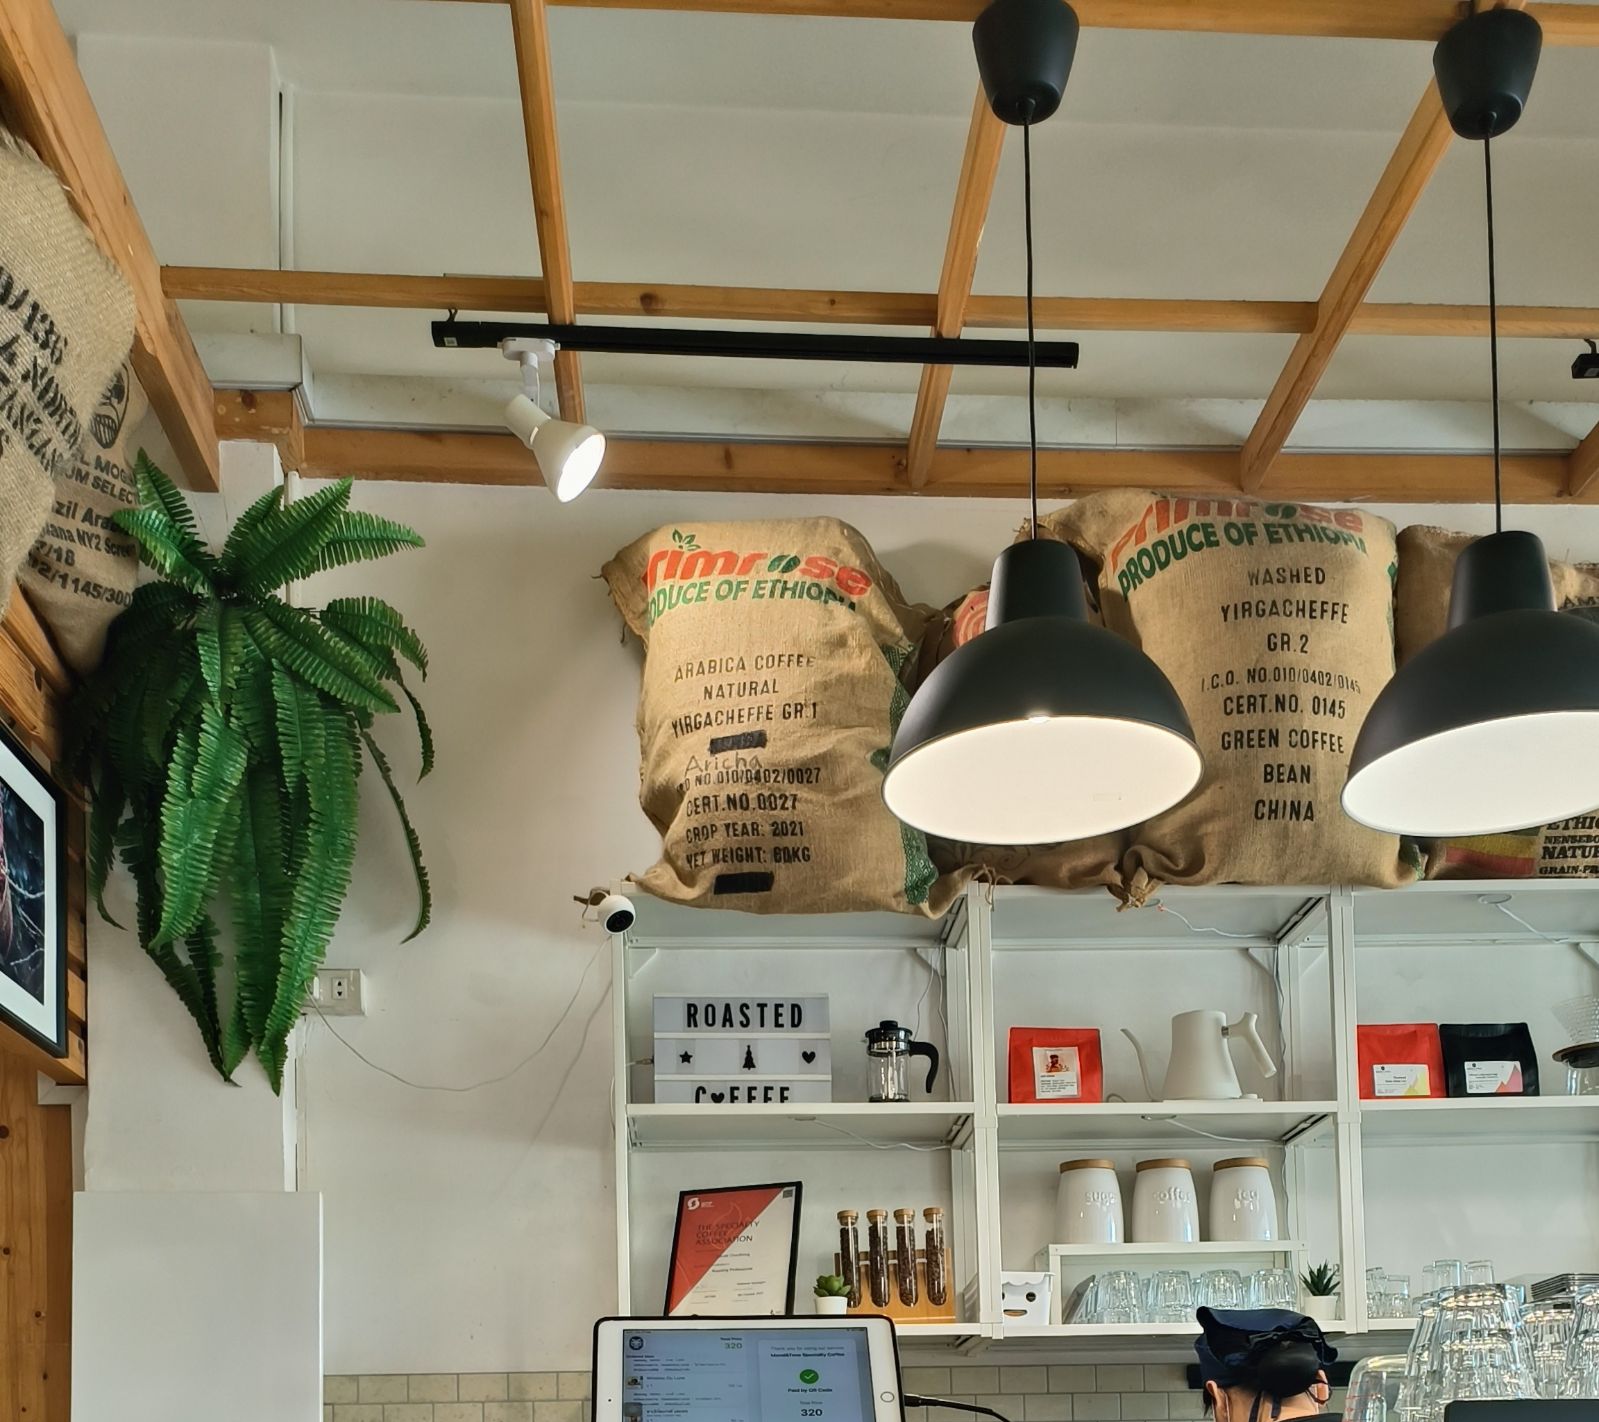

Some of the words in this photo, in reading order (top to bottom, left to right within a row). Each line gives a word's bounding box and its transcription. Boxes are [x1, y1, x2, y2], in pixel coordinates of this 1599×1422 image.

[76, 528, 102, 552] NY2
[1118, 522, 1220, 600] PRODUCE
[1223, 522, 1258, 546] OF
[1248, 567, 1326, 586] WASHED
[715, 580, 749, 602] OF
[1221, 599, 1349, 624] YIRGACHEFFE
[1267, 633, 1309, 654] GR.2
[674, 656, 746, 683] ARABICA
[754, 654, 816, 670] COFFEE
[704, 678, 779, 700] NATURAL
[1312, 696, 1345, 719] 0145
[672, 704, 773, 738] YIRGACHEFFE
[1221, 728, 1279, 750] GREEN
[1289, 728, 1344, 753] COFFEE
[685, 752, 763, 777] Aricha
[1263, 763, 1311, 784] BEAN
[1254, 799, 1314, 822] CHINA
[686, 826, 718, 844] CROP
[724, 822, 765, 839] YEAR:
[772, 821, 804, 837] 2021
[711, 848, 767, 866] WEIGHT:
[686, 1002, 803, 1029] ROASTED
[724, 1342, 742, 1350] 320
[801, 1408, 823, 1417] 320
